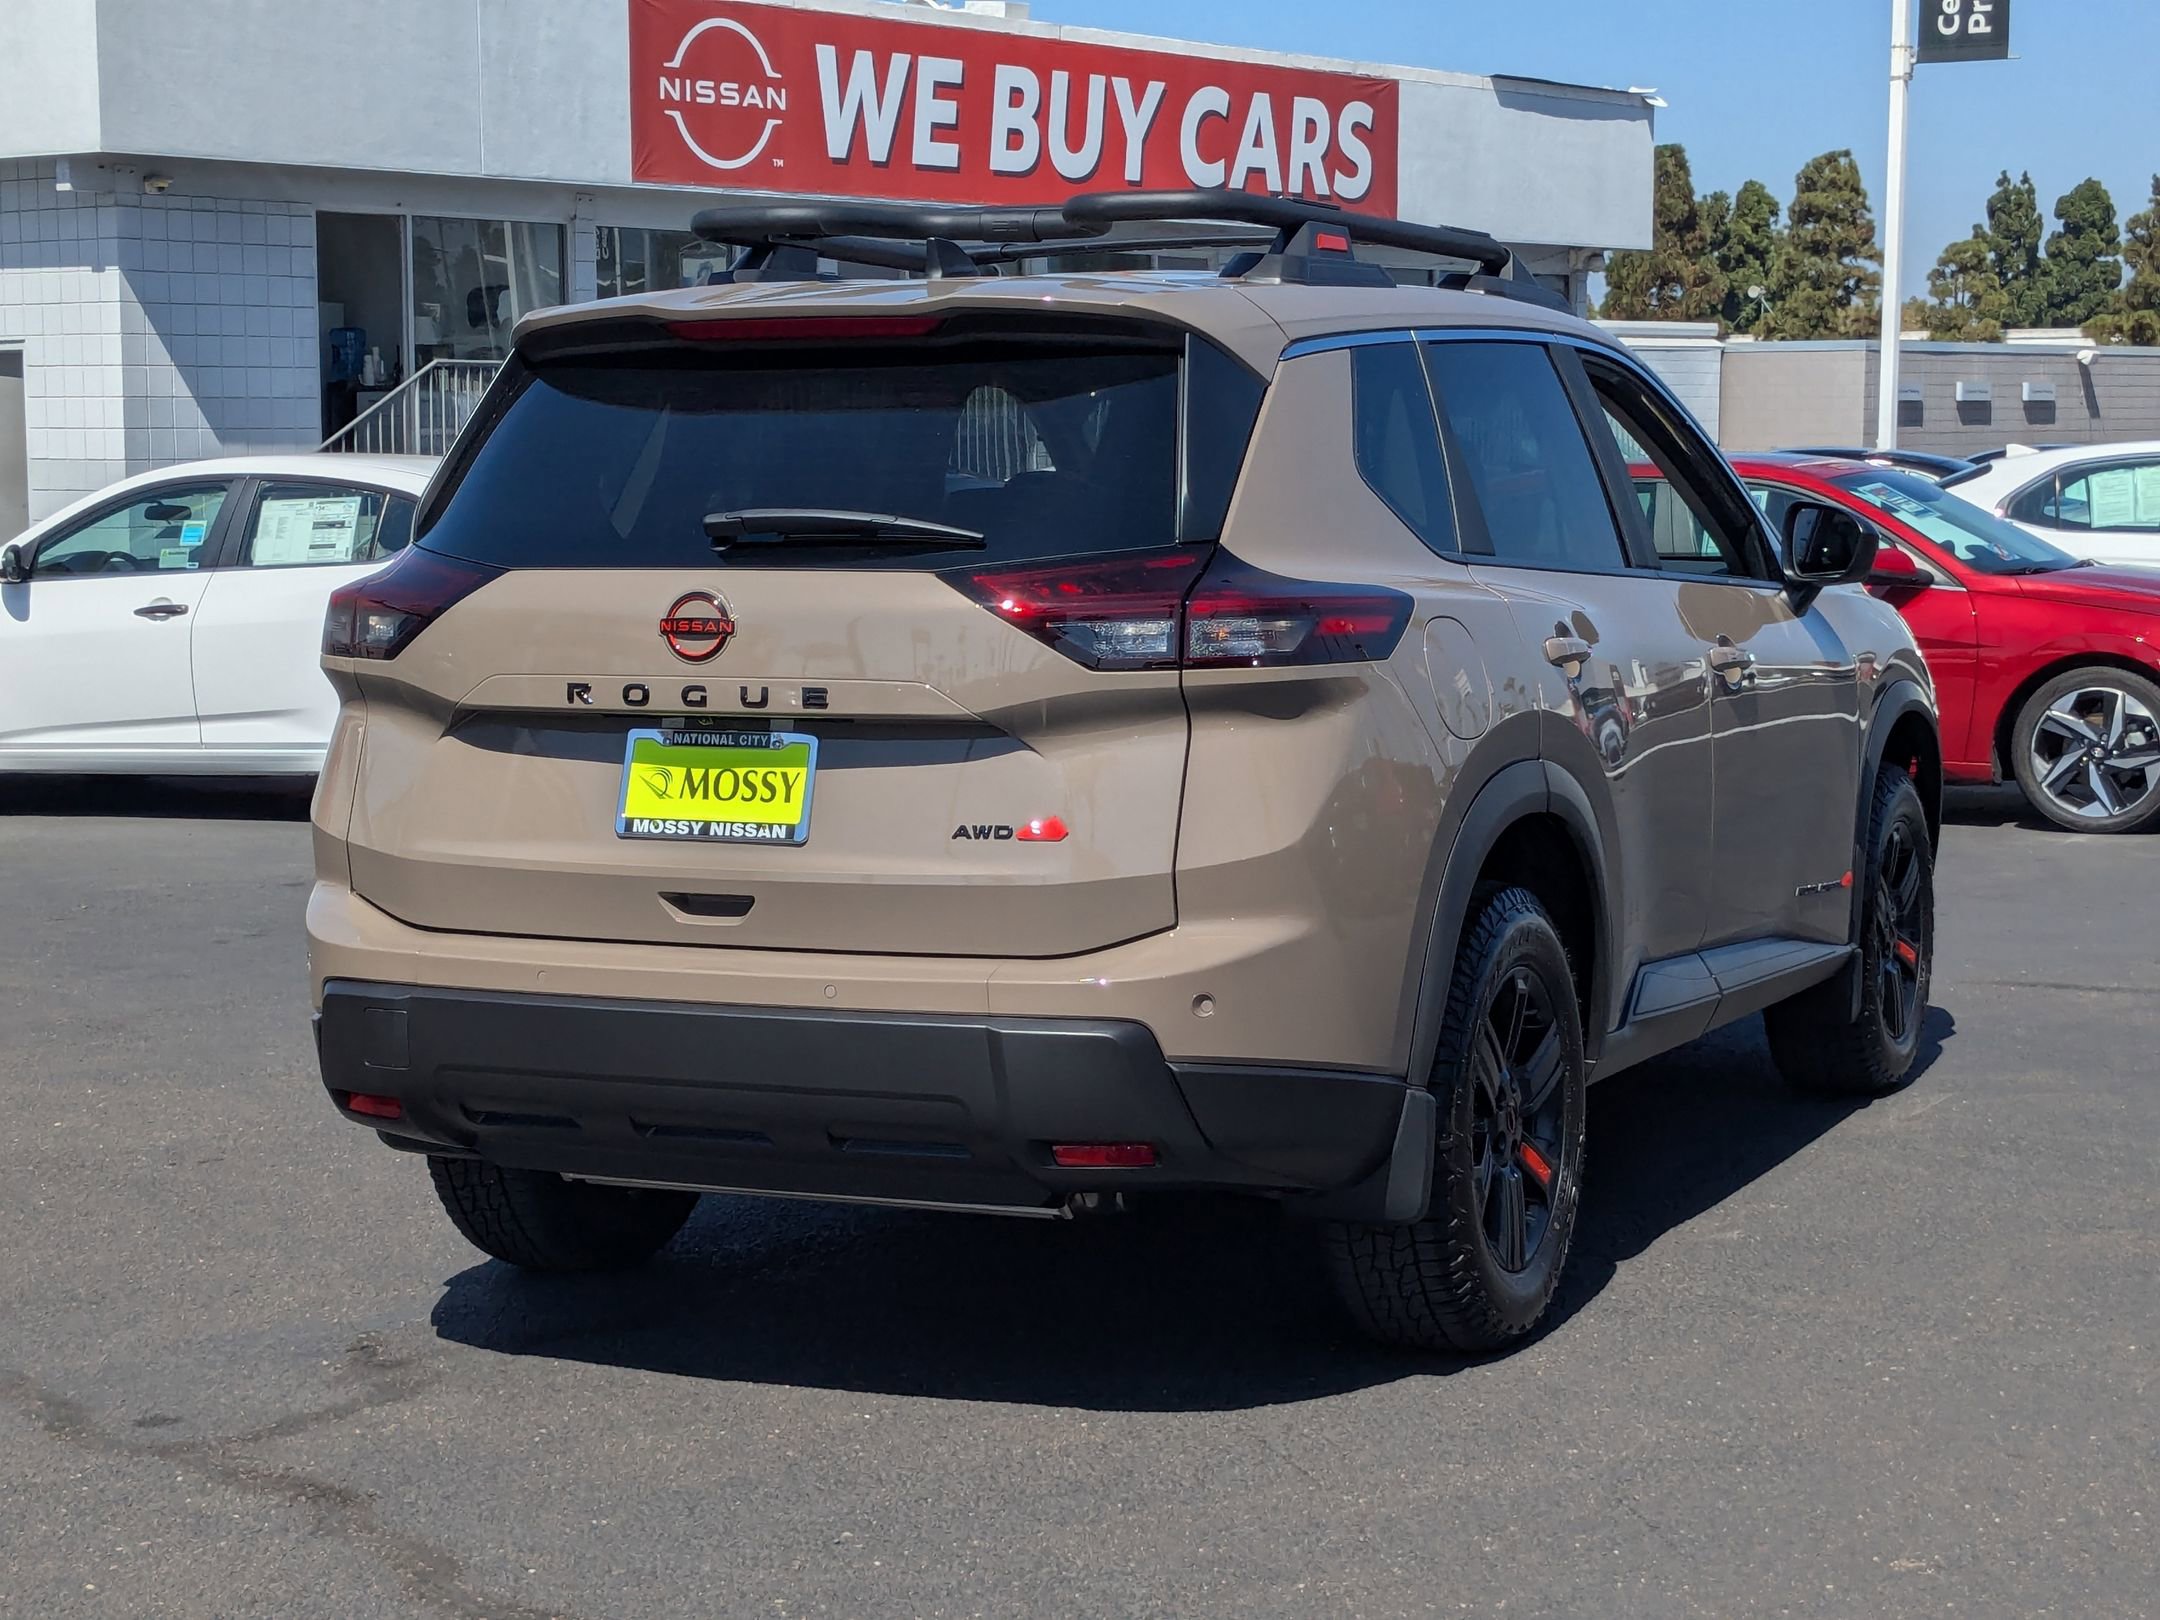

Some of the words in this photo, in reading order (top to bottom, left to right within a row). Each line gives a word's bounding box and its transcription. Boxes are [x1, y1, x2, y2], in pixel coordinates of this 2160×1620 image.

[659, 76, 786, 111] NISSAN
[815, 43, 963, 170] WE
[989, 64, 1166, 183] BUY
[1180, 85, 1374, 199] CARS
[660, 620, 733, 633] NISSAN
[566, 682, 829, 710] ROGUE
[673, 732, 735, 746] NATIONAL
[739, 734, 769, 747] CITY
[680, 767, 800, 803] MOSSY
[632, 818, 704, 835] MOSSY
[709, 821, 786, 839] NISSAN
[951, 824, 1014, 840] AWD
